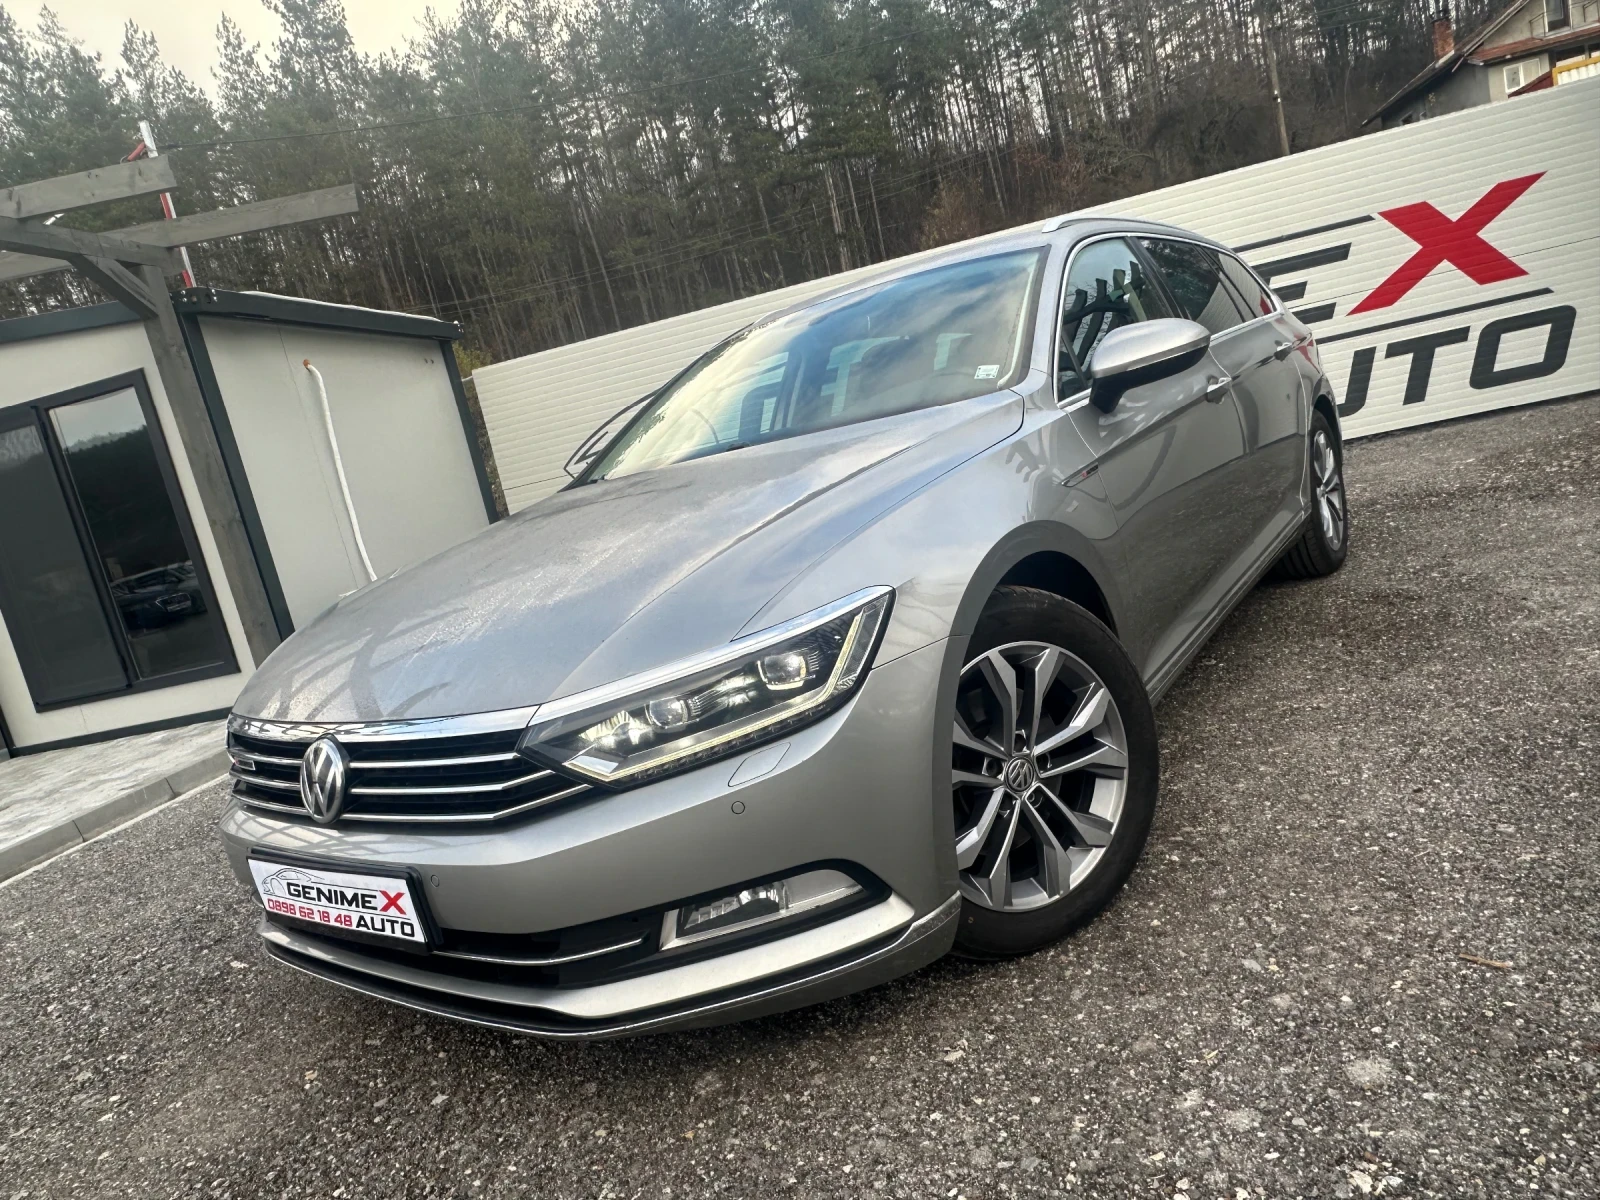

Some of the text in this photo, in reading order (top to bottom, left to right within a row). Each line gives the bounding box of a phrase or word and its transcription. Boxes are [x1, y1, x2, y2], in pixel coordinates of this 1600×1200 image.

[287, 882, 406, 915] GENIMEX
[267, 898, 296, 916] 0898
[298, 906, 315, 920] 62
[317, 909, 331, 923] 18
[355, 915, 415, 937] AUTO
